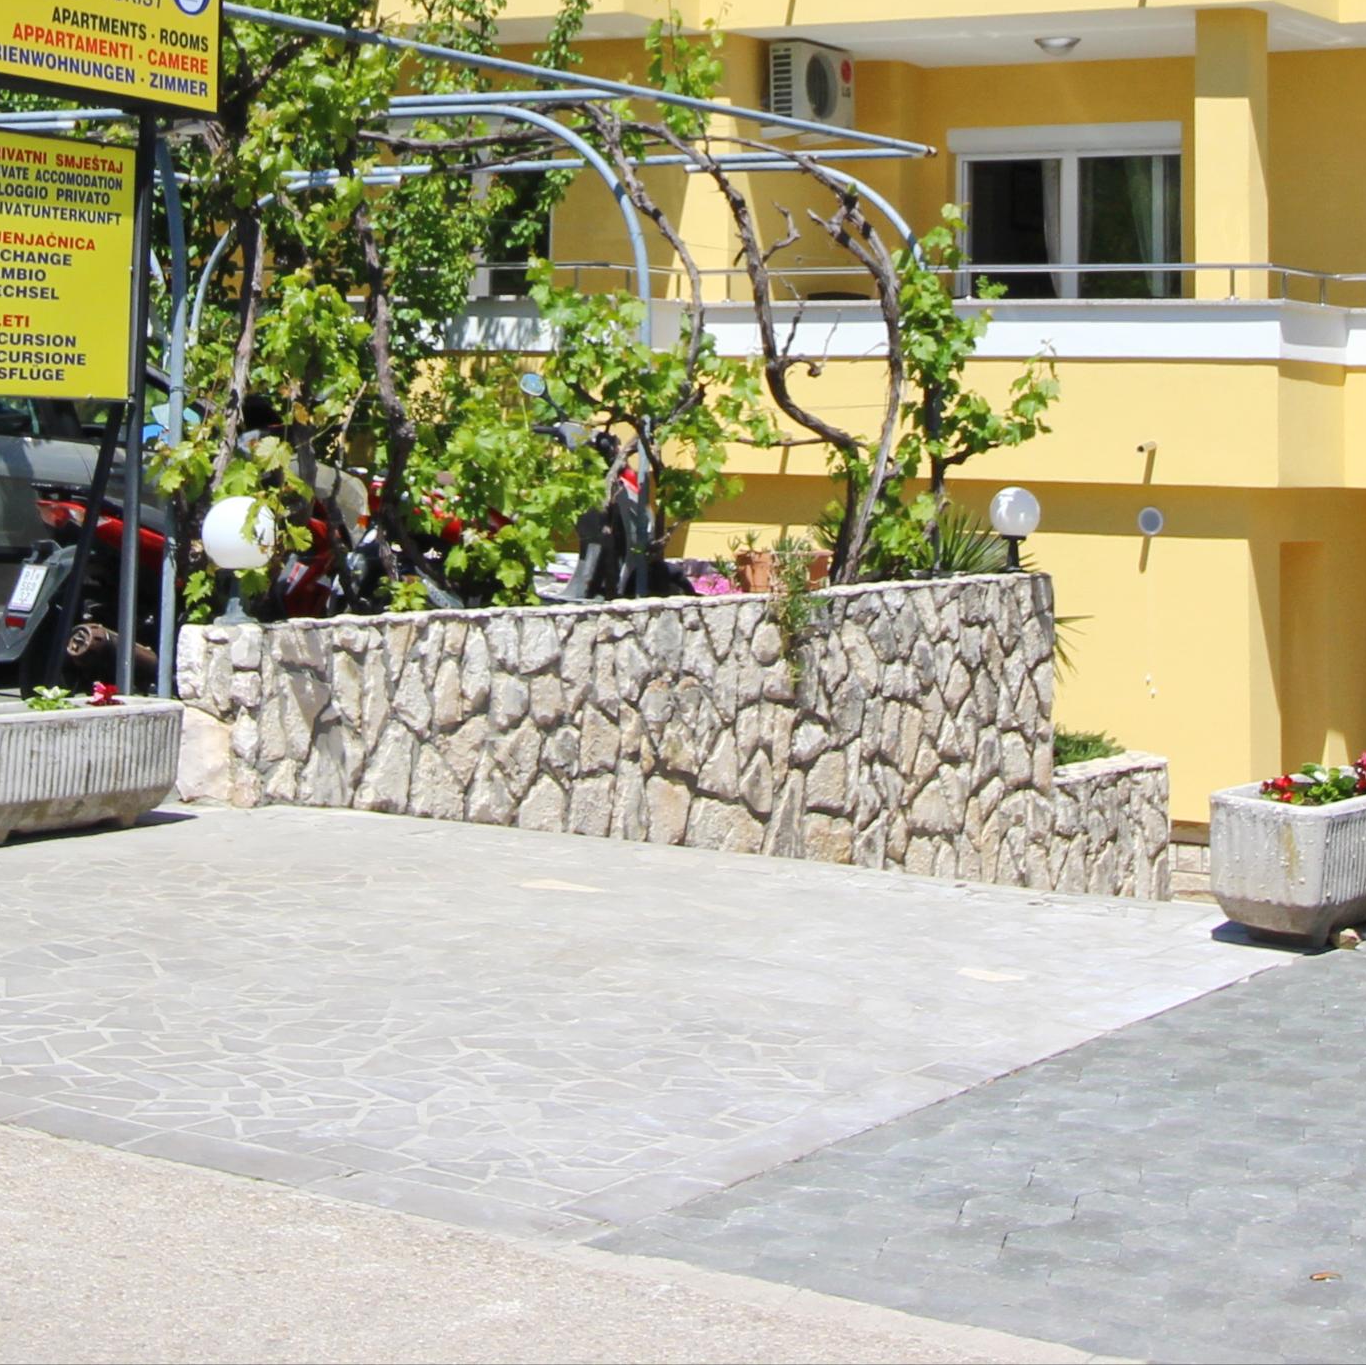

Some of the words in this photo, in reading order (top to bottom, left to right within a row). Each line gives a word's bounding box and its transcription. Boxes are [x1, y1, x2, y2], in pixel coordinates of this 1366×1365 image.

[51, 6, 147, 41] APARTMENTS
[159, 28, 209, 53] ROOMS
[12, 22, 133, 61] APPARTAMENTI
[147, 48, 209, 76] CAMERE
[149, 72, 209, 98] ZIMMER
[55, 153, 124, 174] SMJEŠTAJ
[35, 169, 123, 191] ACCOMODATION
[56, 188, 110, 206] PRIVATO
